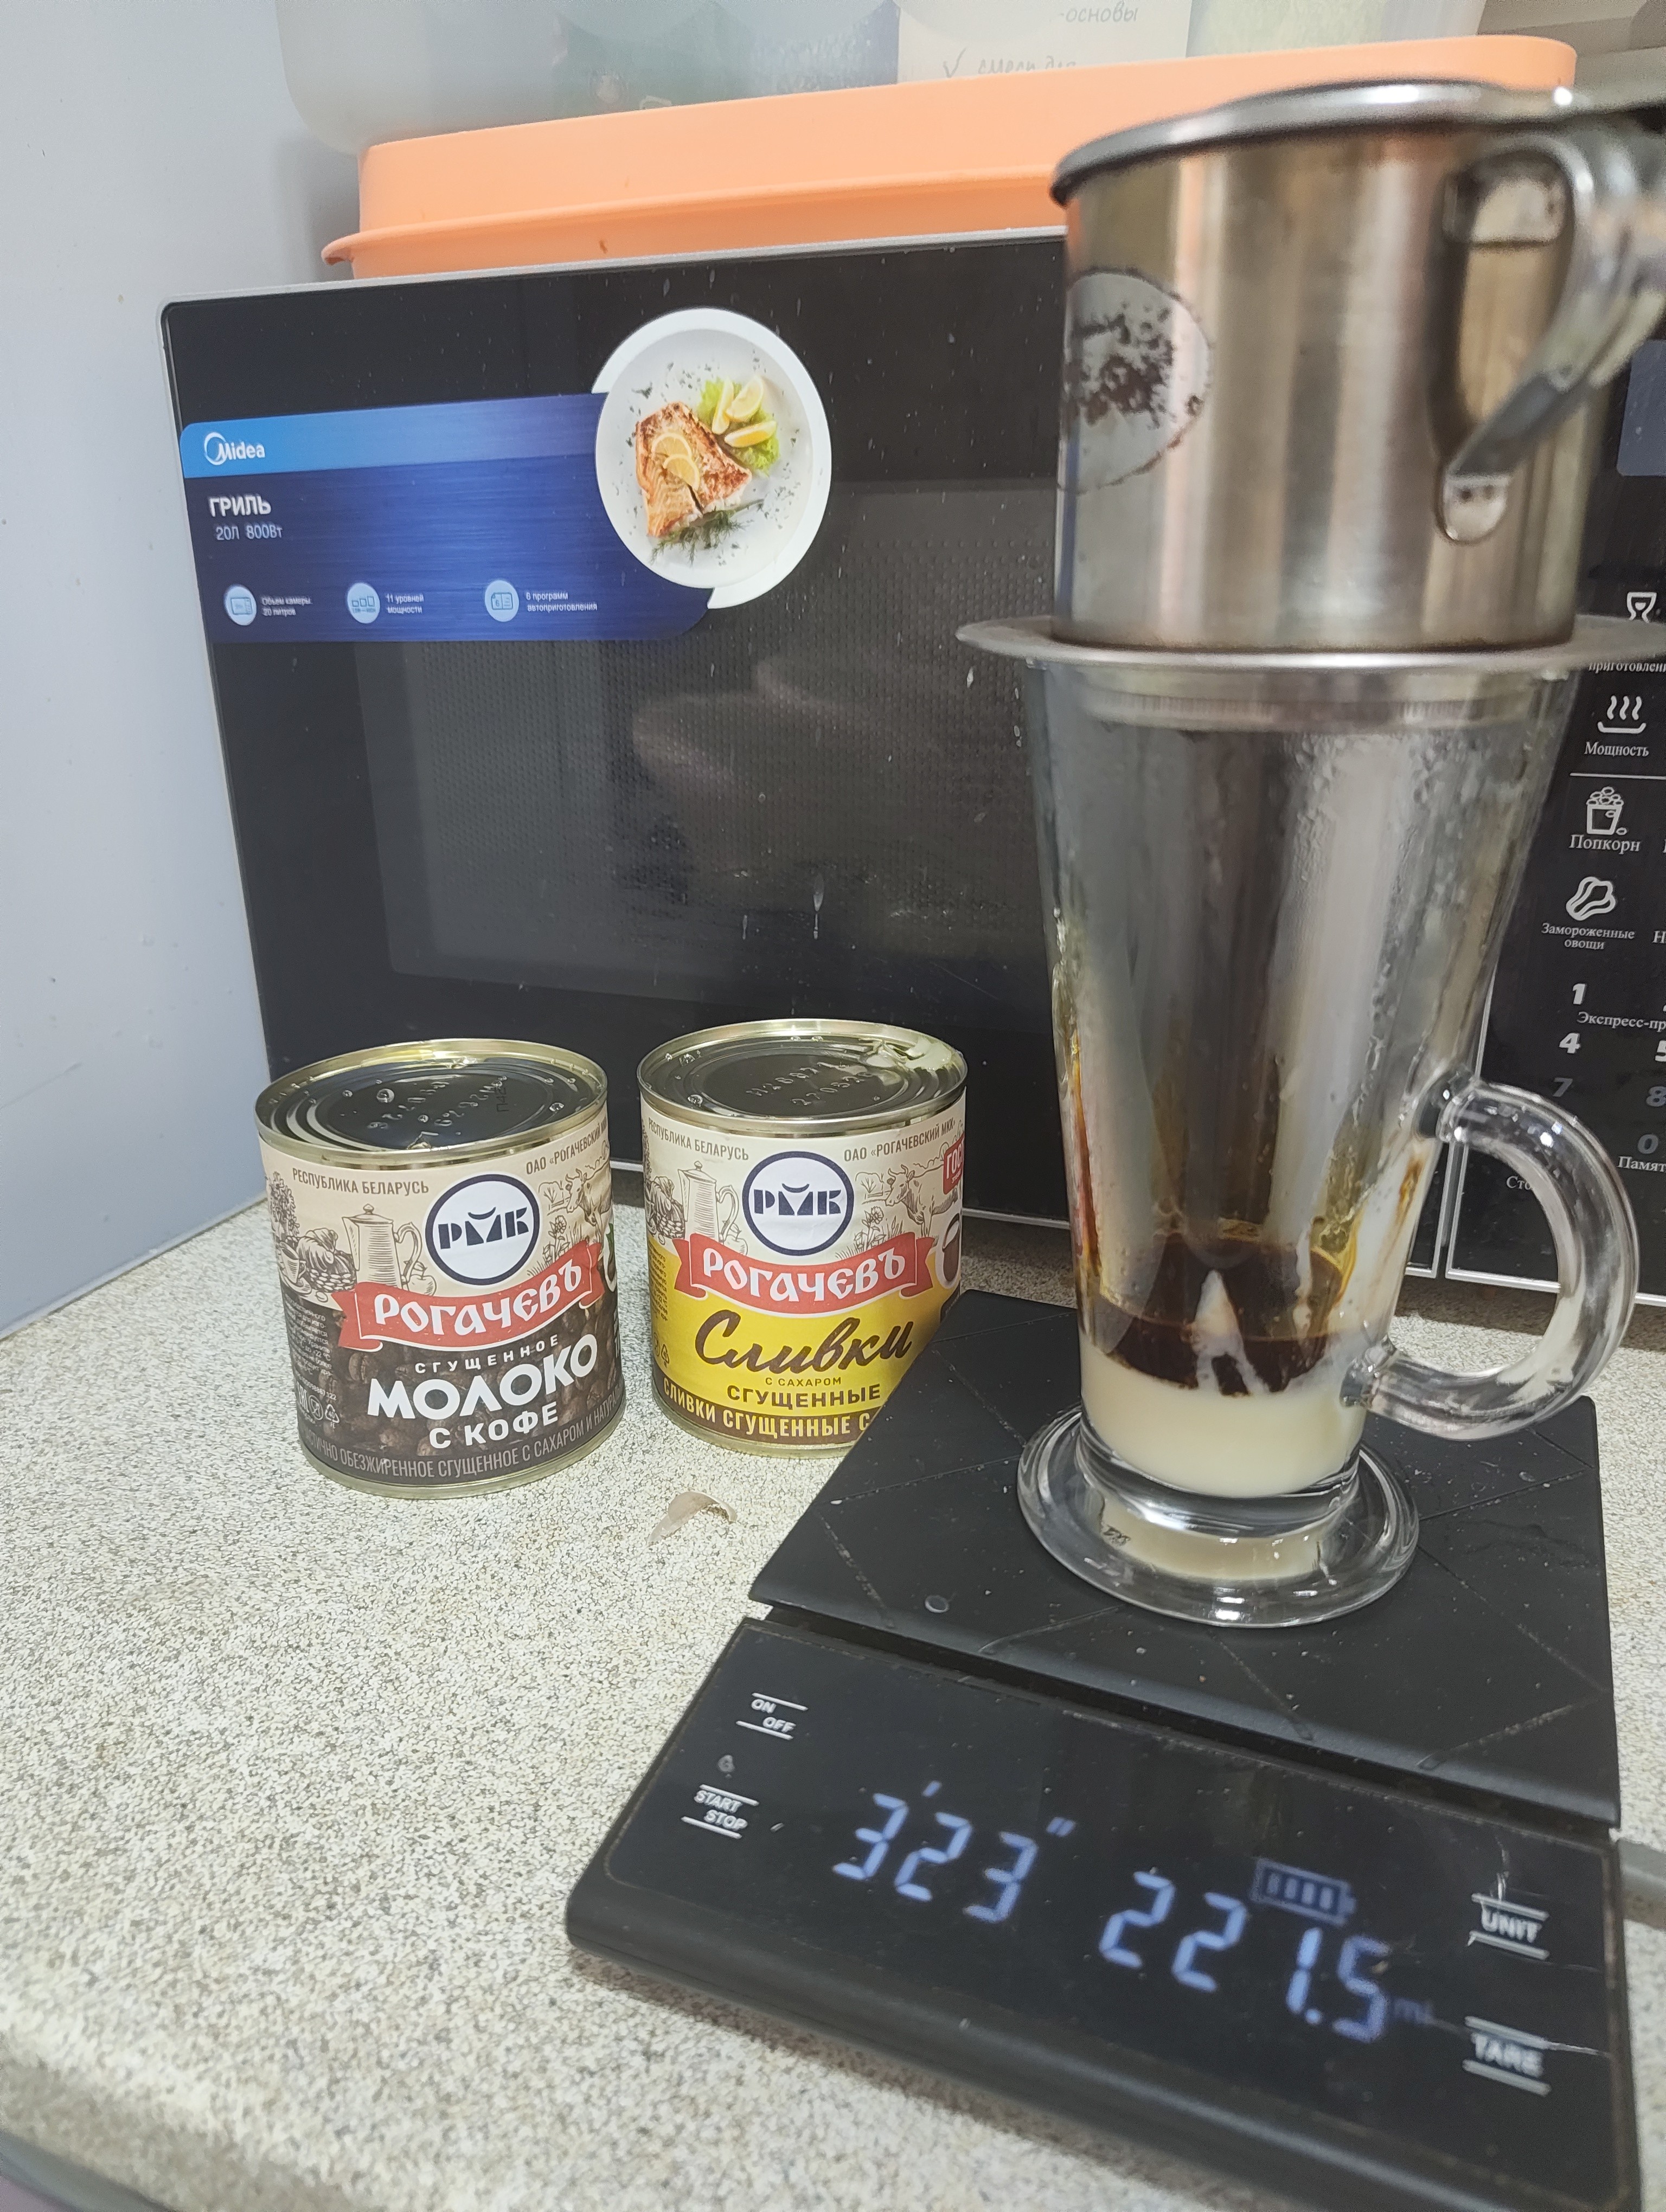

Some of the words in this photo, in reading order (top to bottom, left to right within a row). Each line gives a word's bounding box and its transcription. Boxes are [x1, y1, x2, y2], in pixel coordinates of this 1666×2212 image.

[203, 432, 266, 466] Midea
[209, 494, 272, 517] ГРИЛЬ
[216, 525, 240, 541] 20Л
[246, 523, 283, 540] 800Вт
[386, 593, 394, 603] 11
[533, 591, 568, 602] программ
[387, 605, 422, 615] мощности
[1585, 741, 1650, 758] Мощность
[1568, 833, 1641, 853] Попкорн
[1541, 923, 1635, 940] Замороженные
[1564, 938, 1606, 950] овощи
[1572, 983, 1588, 1005] 1
[1559, 1032, 1580, 1053] 4
[1552, 1077, 1573, 1098] 7
[1646, 1086, 1666, 1107] 8
[648, 1117, 692, 1150] РЕСПУБЛИКА
[694, 1139, 749, 1161] БЕЛАРУСЬ
[1638, 1134, 1659, 1154] 0
[844, 1147, 867, 1162] ОАО
[1617, 1156, 1666, 1173] Памят
[526, 1156, 546, 1175] ОАО
[292, 1167, 359, 1193] РЕСПУБЛИКА
[362, 1181, 429, 1196] БЕЛАРУСЬ
[695, 1309, 913, 1374] Сливки
[414, 1334, 559, 1374] СГУЩЕННОЕ
[367, 1334, 597, 1420] МОЛОКО
[778, 1377, 842, 1387] САХАРОМ
[727, 1384, 881, 1410] СГУЩЕННЫЕ
[663, 1377, 716, 1424] СЛИВКИ
[723, 1410, 850, 1439] СГУЩЕННЫЕ
[430, 1427, 451, 1449] С
[465, 1401, 558, 1446] КОФЕ
[340, 1448, 434, 1478] ОБЕЗЖИРЕННОЕ
[438, 1448, 519, 1478] СГУЩЕННОЕ
[522, 1445, 531, 1462] С
[534, 1419, 584, 1457] САХАРОМ
[586, 1413, 592, 1432] И
[751, 1698, 777, 1714] ON
[762, 1716, 797, 1734] OFF
[694, 1790, 744, 1813] START
[704, 1809, 748, 1831] STOP
[1481, 1902, 1542, 1943] UNIT
